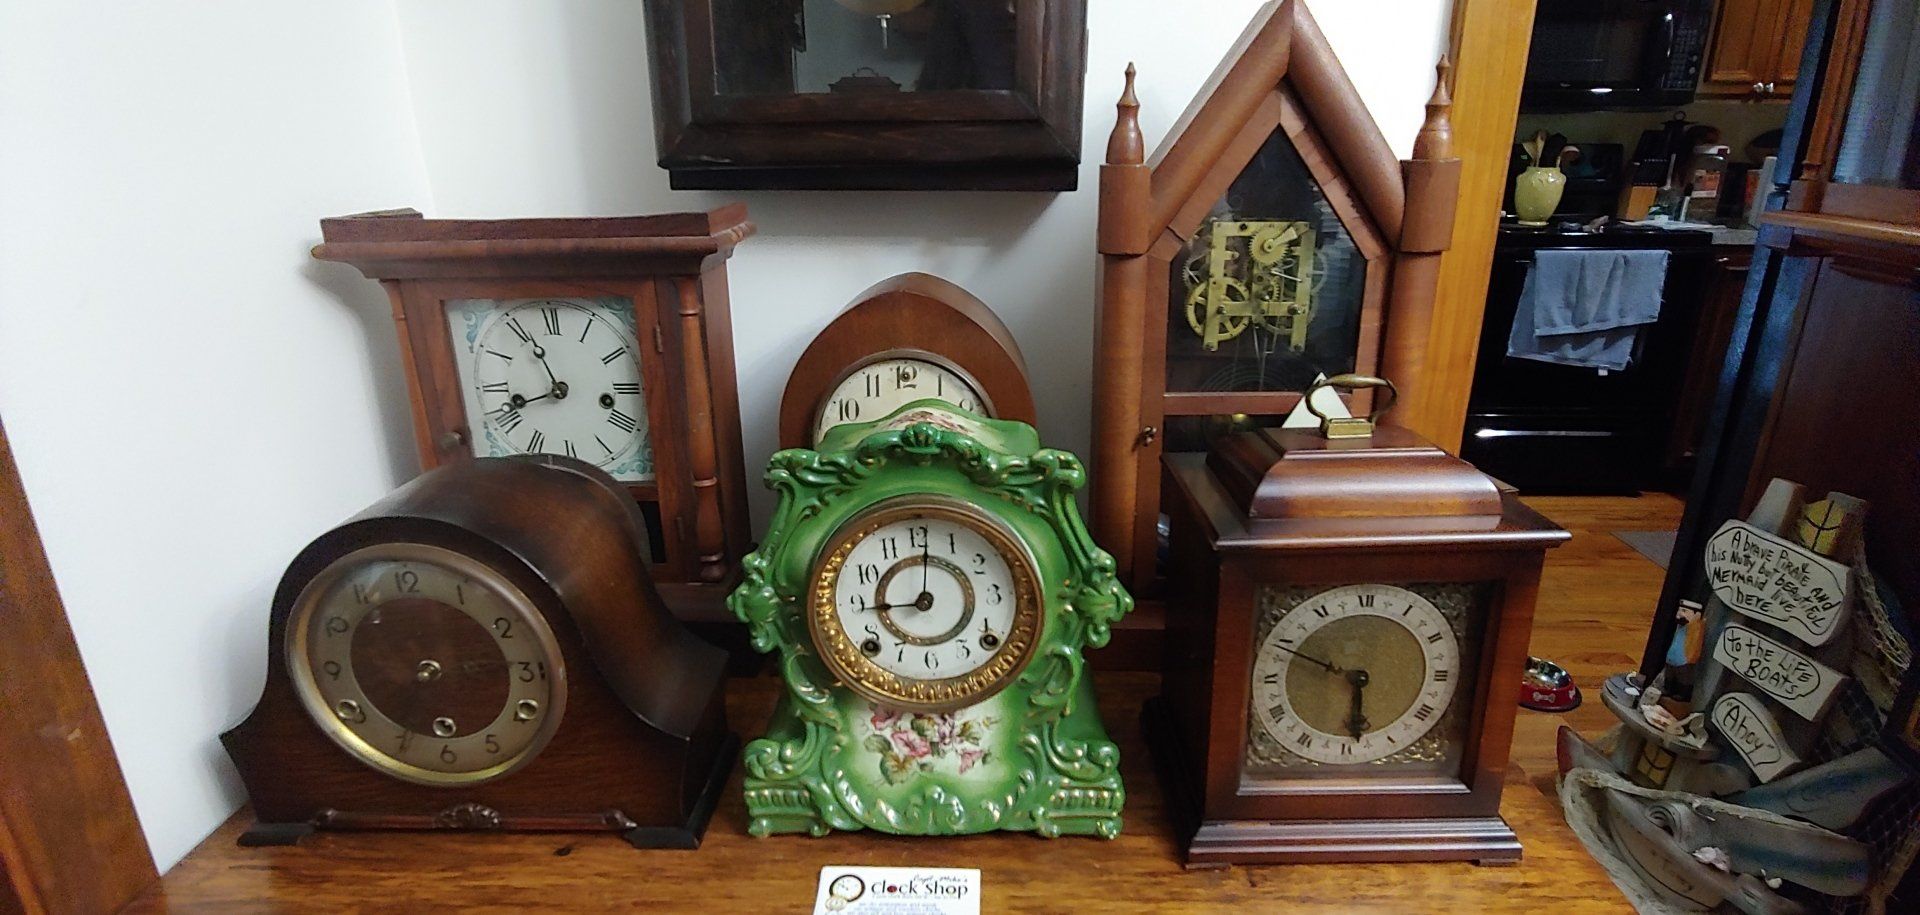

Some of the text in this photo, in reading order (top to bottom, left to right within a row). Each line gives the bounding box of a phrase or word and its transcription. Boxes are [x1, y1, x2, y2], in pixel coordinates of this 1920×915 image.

[865, 373, 881, 398] 11
[895, 365, 918, 390] 12
[936, 372, 943, 398] 1
[838, 397, 861, 422] 10
[908, 525, 930, 549] 12
[949, 532, 957, 554] 1
[1731, 530, 1742, 550] A
[881, 537, 899, 560] 11
[1711, 542, 1728, 563] his
[858, 564, 879, 586] 10
[971, 553, 987, 576] 2
[395, 570, 421, 594] 12
[456, 584, 466, 606] 1
[850, 594, 866, 614] 9
[986, 583, 1002, 606] 3
[492, 617, 514, 640] 2
[894, 641, 907, 663] 7
[955, 638, 970, 660] 5
[1726, 630, 1742, 652] to
[323, 660, 342, 682] 9
[924, 650, 940, 671] 6
[518, 661, 536, 684] 3
[440, 744, 457, 766] 6
[484, 734, 500, 755] 5
